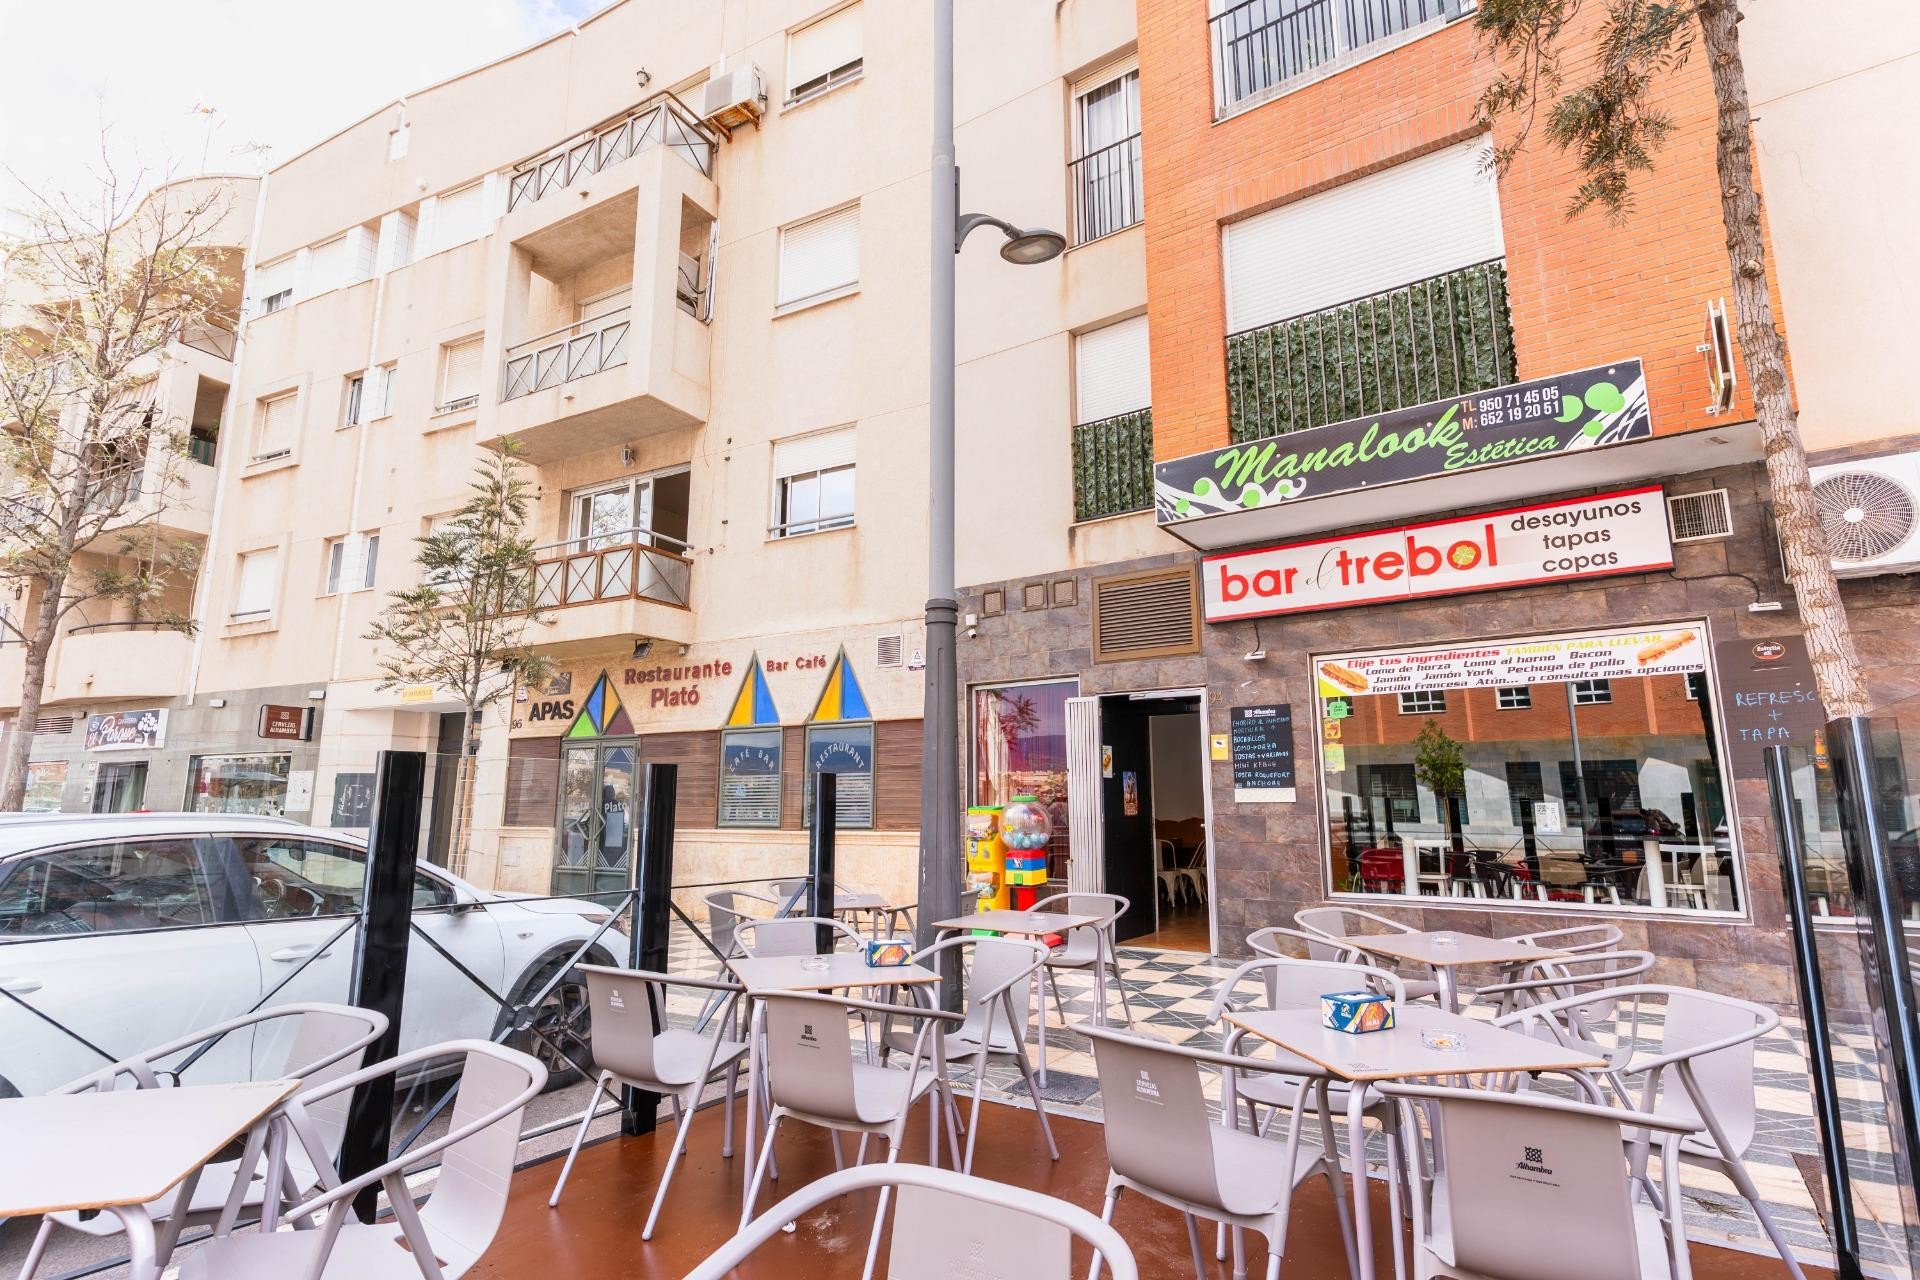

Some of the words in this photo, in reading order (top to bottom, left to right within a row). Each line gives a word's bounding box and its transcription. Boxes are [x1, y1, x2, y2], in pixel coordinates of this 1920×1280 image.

[1460, 400, 1477, 413] TL
[1479, 396, 1502, 412] 950
[1505, 393, 1520, 408] 71
[1523, 389, 1539, 404] 45
[1542, 386, 1559, 401] 05
[1462, 417, 1478, 431] M:
[1480, 410, 1504, 426] 652
[1507, 407, 1522, 421] 19
[1525, 404, 1541, 418] 20
[1544, 400, 1560, 415] 51
[1215, 404, 1464, 489] Manalook
[1444, 435, 1560, 470] Estética
[1511, 500, 1642, 531] desayunos
[1543, 529, 1611, 551] tapas
[1220, 564, 1298, 602] bar
[1336, 523, 1498, 586] trebol
[1542, 551, 1618, 573] copas
[1566, 639, 1604, 651] PARA
[1608, 634, 1663, 648] LLEVAR
[766, 659, 789, 673] Bar
[795, 655, 827, 669] Café
[1347, 659, 1374, 670] Elije
[1379, 658, 1402, 666] tus
[1406, 649, 1500, 665] ingredientes
[1463, 659, 1497, 668] Lomo
[1501, 656, 1512, 665] al
[1516, 653, 1556, 664] horno
[1569, 649, 1612, 659] Bacon
[624, 657, 733, 685] Restaurante
[1365, 667, 1395, 676] Lomo
[1398, 665, 1413, 673] de
[1422, 671, 1461, 681] Jamón
[1466, 668, 1494, 677] York
[1507, 663, 1564, 674] Pechuga
[1568, 660, 1585, 669] de
[1590, 657, 1625, 669] pollo
[1540, 671, 1599, 682] consulta
[1603, 667, 1633, 677] mas
[1637, 662, 1704, 675] opciones
[1372, 684, 1411, 693] Tortilla
[1414, 680, 1468, 690] Francesa
[1373, 674, 1411, 684] Jamón
[650, 684, 700, 708] Plató
[1735, 690, 1816, 707] REFRESC
[1739, 727, 1790, 742] TAPA
[757, 749, 775, 770] BAR
[815, 742, 865, 770] RESTAURANT
[1515, 1161, 1553, 1175] Alhambra
